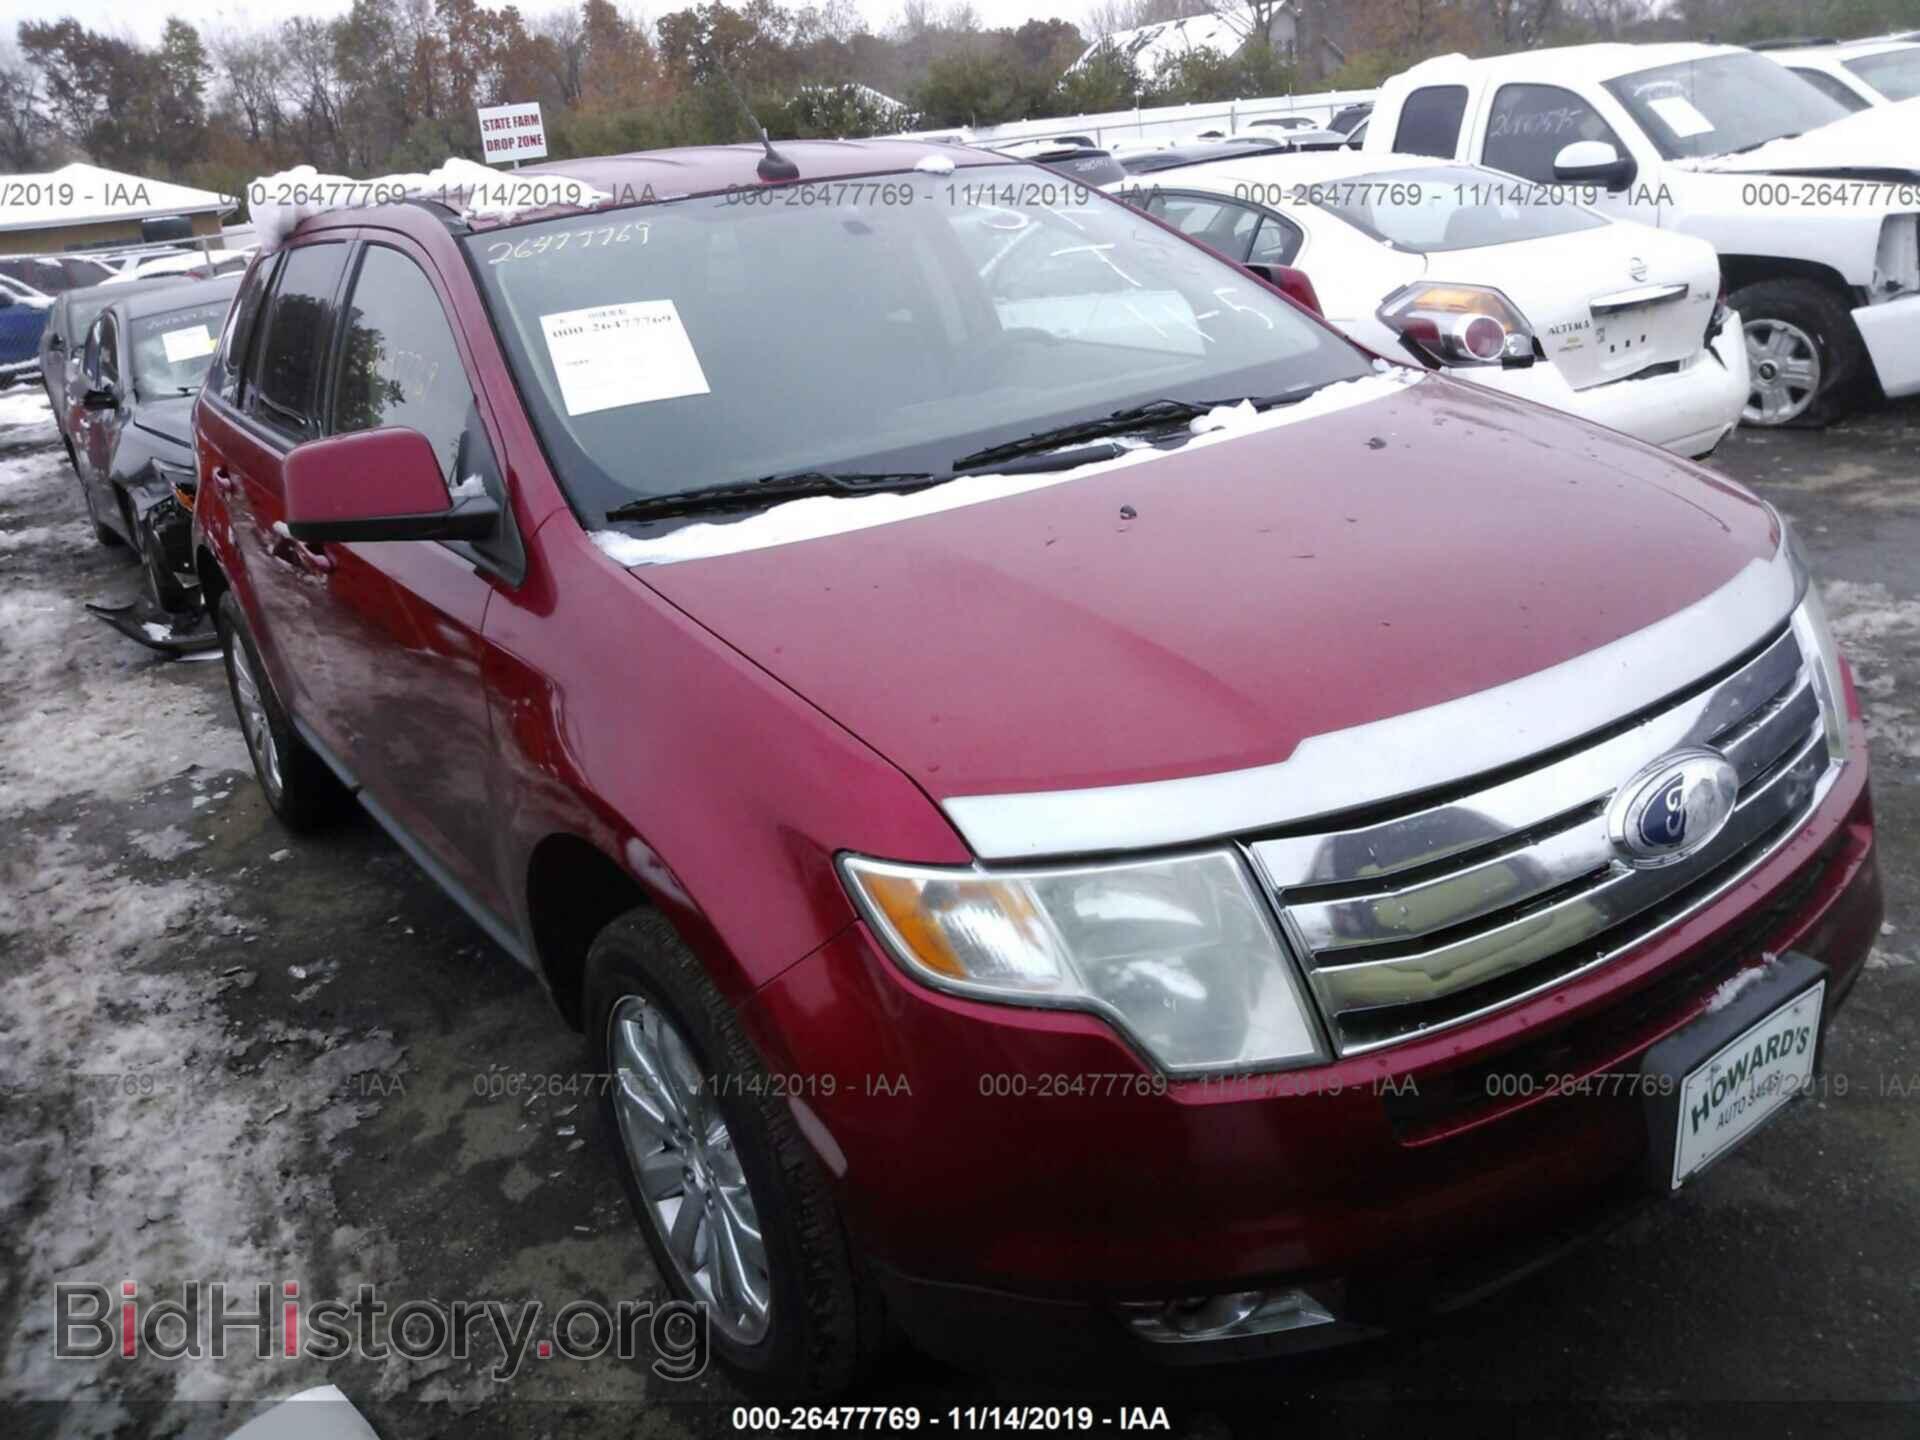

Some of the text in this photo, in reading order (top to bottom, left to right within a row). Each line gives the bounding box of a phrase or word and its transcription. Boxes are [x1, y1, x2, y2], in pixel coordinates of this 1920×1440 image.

[482, 113, 540, 132] STATE FARM
[486, 133, 544, 152] DROP ZONE
[1548, 320, 1590, 335] ALTIMA
[1691, 1026, 1810, 1134] HOWARD'S
[1716, 1096, 1747, 1131] AUTO
